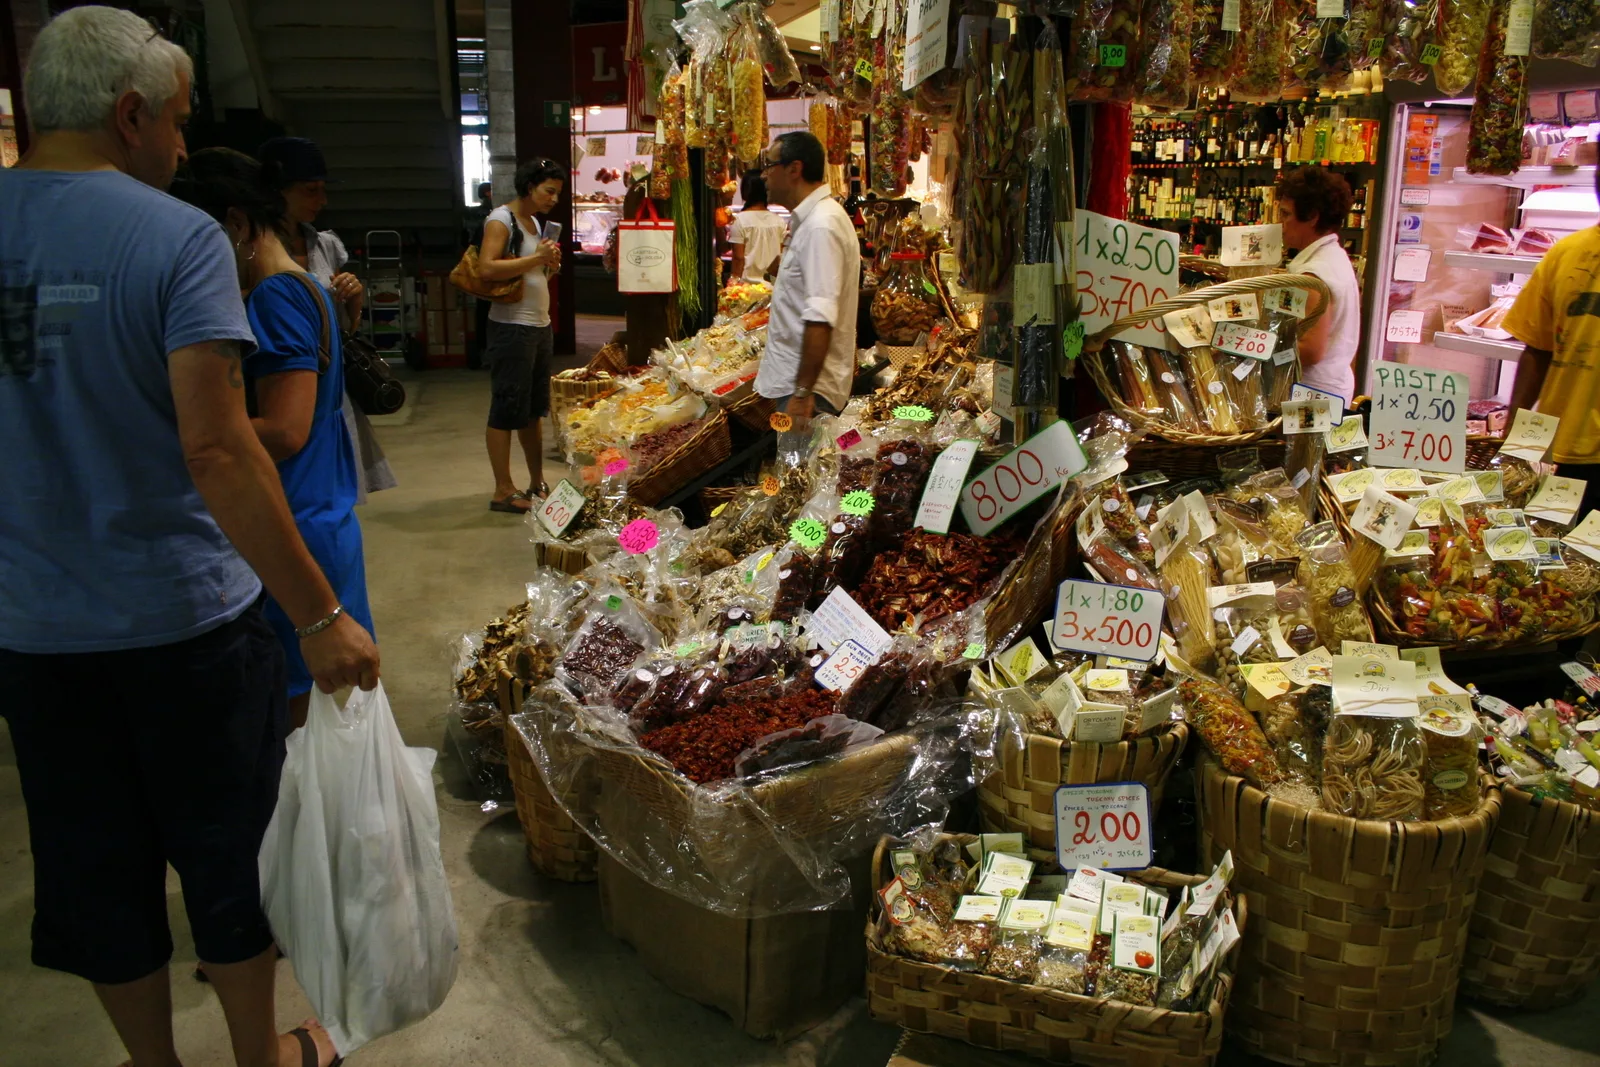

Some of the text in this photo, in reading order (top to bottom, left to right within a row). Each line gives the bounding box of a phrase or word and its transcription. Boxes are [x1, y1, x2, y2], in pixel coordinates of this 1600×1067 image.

[1375, 367, 1456, 396] PASTA
[970, 449, 1044, 522] 8,00
[849, 652, 869, 668] TOMAT
[1359, 680, 1391, 693] Pici
[1082, 715, 1117, 724] ORTOLANA
[1085, 794, 1140, 803] TUSCANY SPICES
